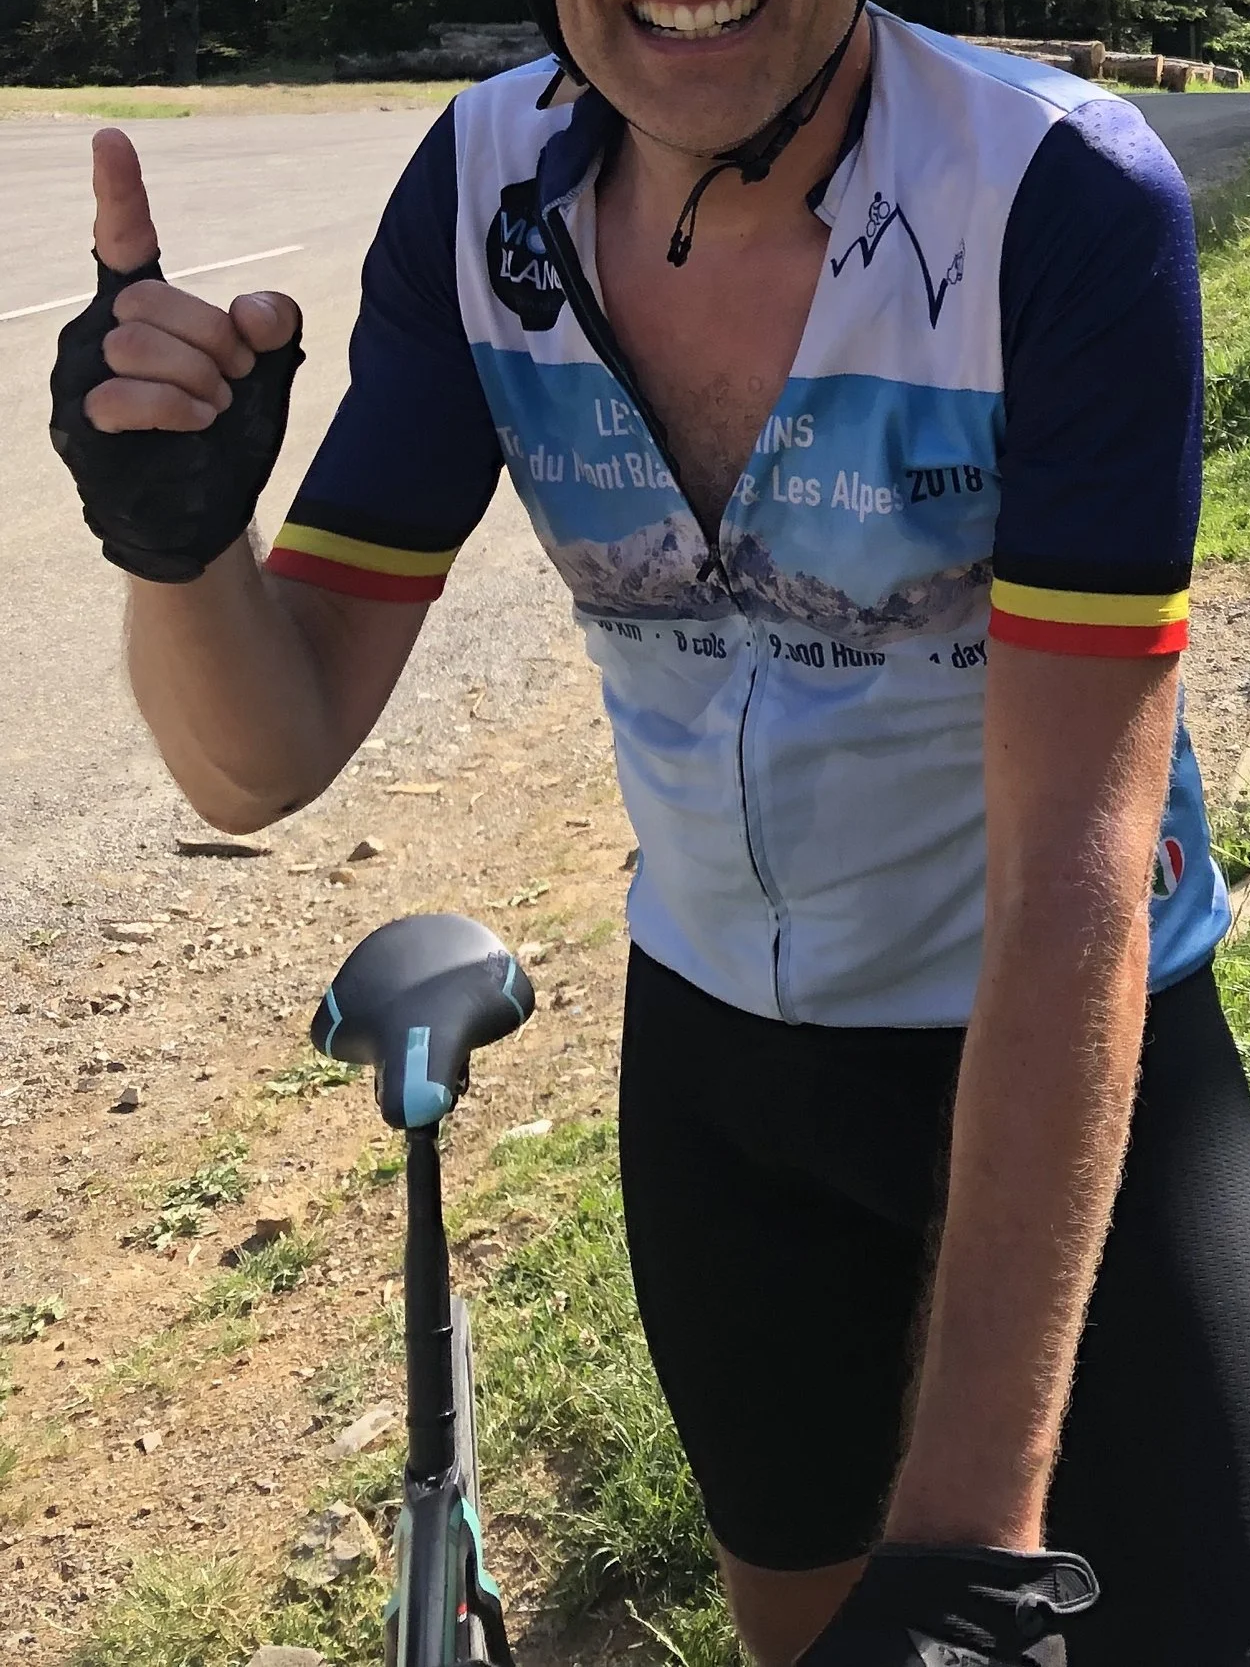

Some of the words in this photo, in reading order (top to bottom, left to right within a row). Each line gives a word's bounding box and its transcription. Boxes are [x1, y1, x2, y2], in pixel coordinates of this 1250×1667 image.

[529, 444, 564, 483] du
[772, 465, 821, 506] Les
[831, 470, 904, 523] Alpes
[905, 464, 984, 504] 2018
